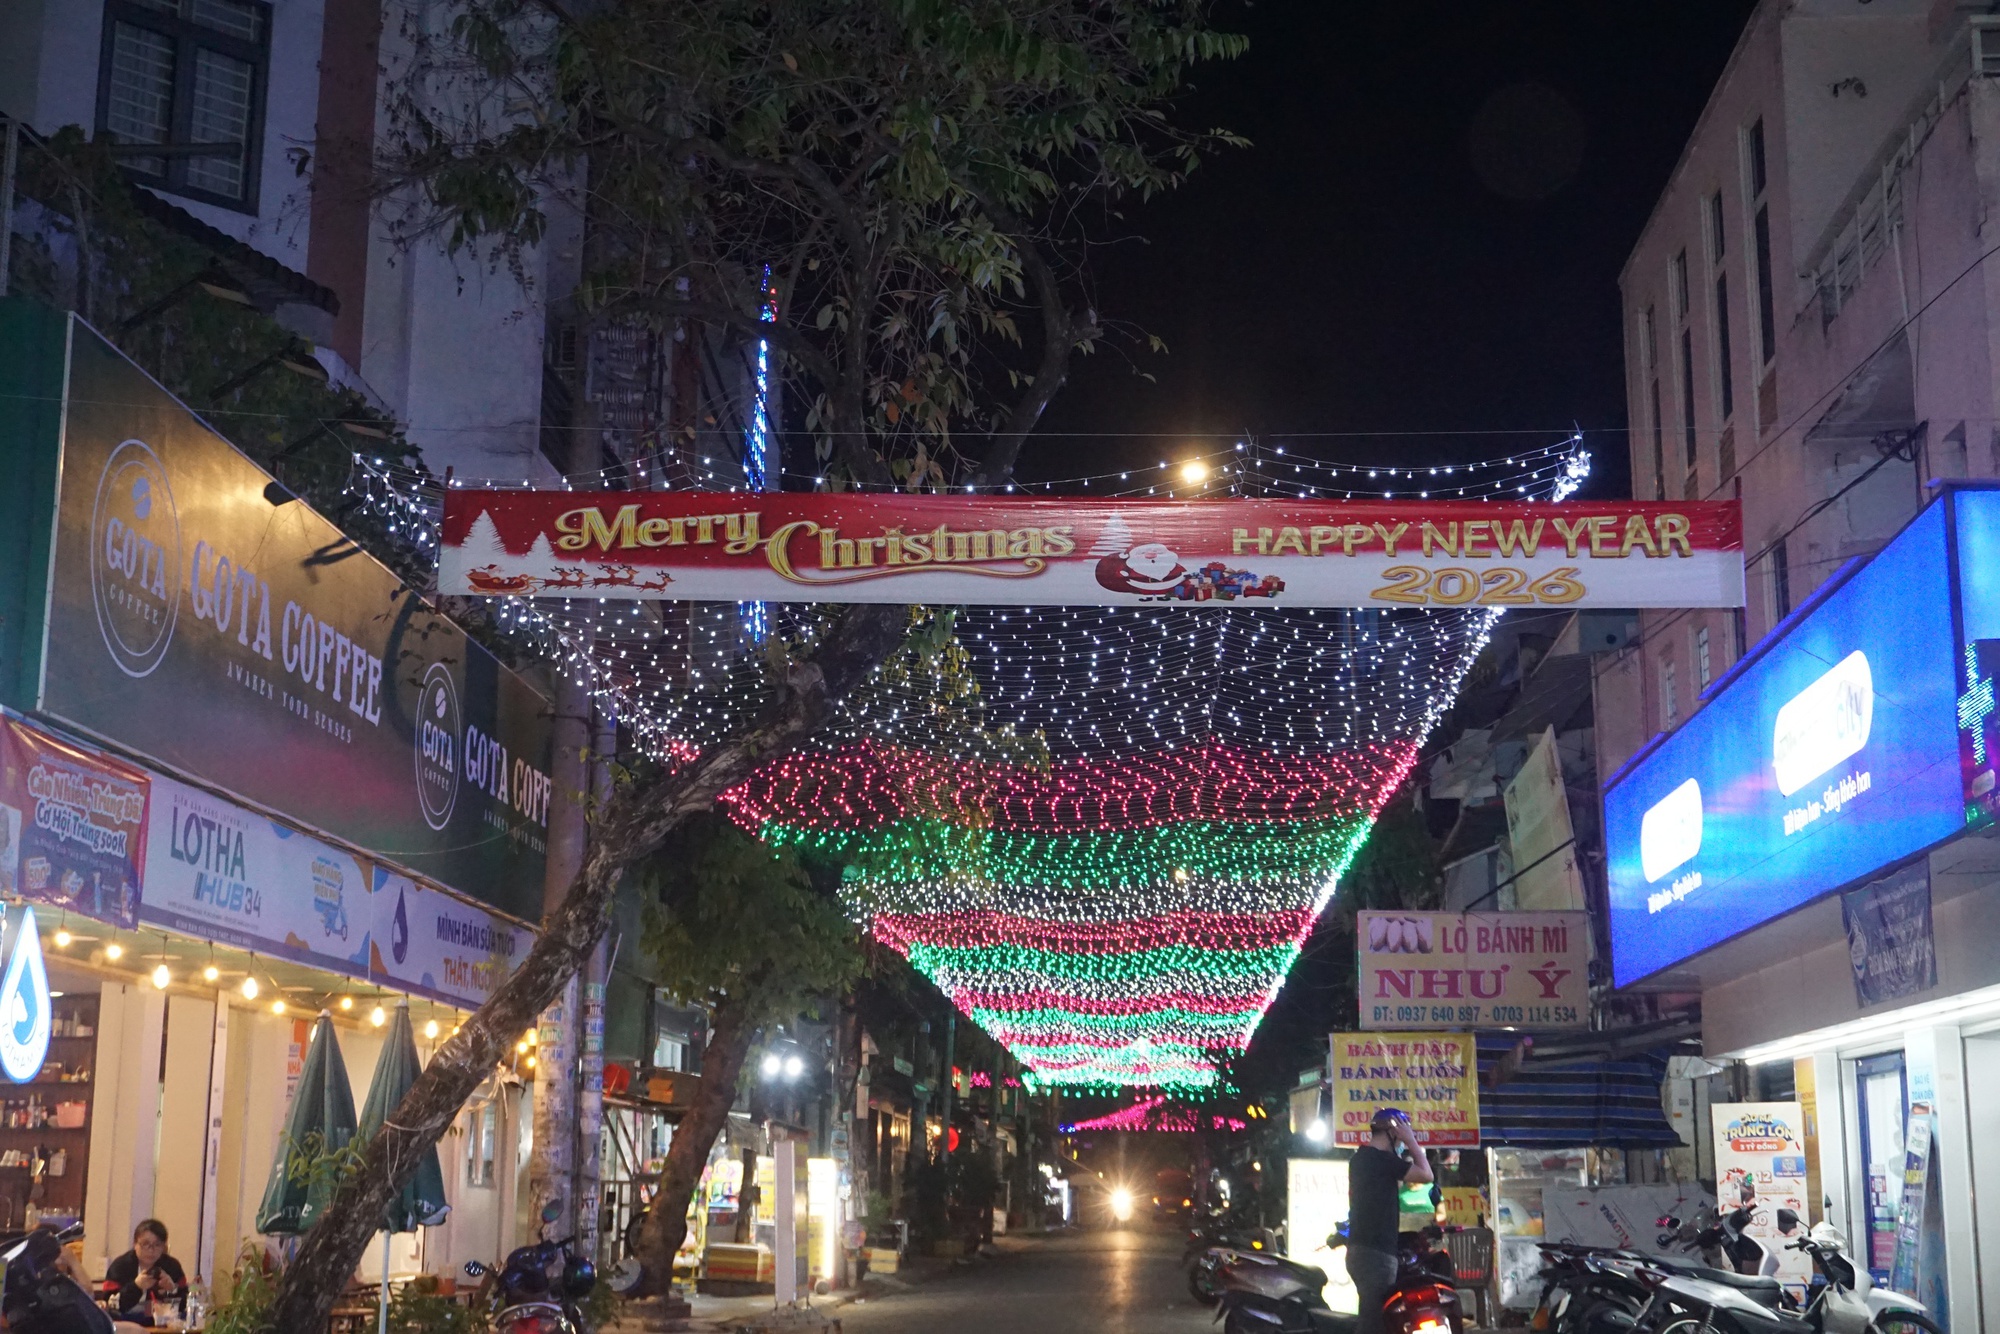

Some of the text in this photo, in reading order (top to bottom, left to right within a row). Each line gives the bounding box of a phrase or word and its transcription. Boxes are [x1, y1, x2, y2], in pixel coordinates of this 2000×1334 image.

[554, 503, 1076, 586] Merry Christmas
[1232, 513, 1695, 560] HAPPY NEW YEAR
[106, 516, 166, 600] GOTA
[109, 583, 159, 625] COFFEE
[1369, 564, 1589, 607] 2026
[191, 540, 382, 727] GOTA COFFEE
[227, 660, 352, 744] AWAKEN YOUR SENSES
[422, 719, 454, 773] GOTA
[465, 724, 551, 828] GOTA COFF
[1823, 785, 1841, 813] Sống
[37, 800, 51, 827] Cơ
[51, 804, 72, 840] Hội
[170, 806, 245, 882] LOTHA
[436, 912, 461, 944] MÌNH
[462, 919, 480, 949] BÁN
[1441, 919, 1568, 954] LÒ BÁNH MÌ
[1374, 960, 1572, 999] NHƯ Ý
[1373, 1006, 1394, 1022] ĐT:
[1397, 1006, 1426, 1021] 0937
[1431, 1006, 1454, 1021] 640
[1458, 1006, 1481, 1021] 897
[1492, 1006, 1524, 1022] 0703
[1528, 1006, 1550, 1022] 114
[1554, 1006, 1578, 1022] 534
[1347, 1040, 1407, 1057] BÁNH
[1340, 1060, 1468, 1080] BÁNH CUỐN
[1349, 1086, 1408, 1101] BÁNH
[1417, 1107, 1469, 1124] NGÃI
[1722, 1123, 1795, 1141] TRÚNG LỚN
[1756, 1171, 1773, 1184] 12
